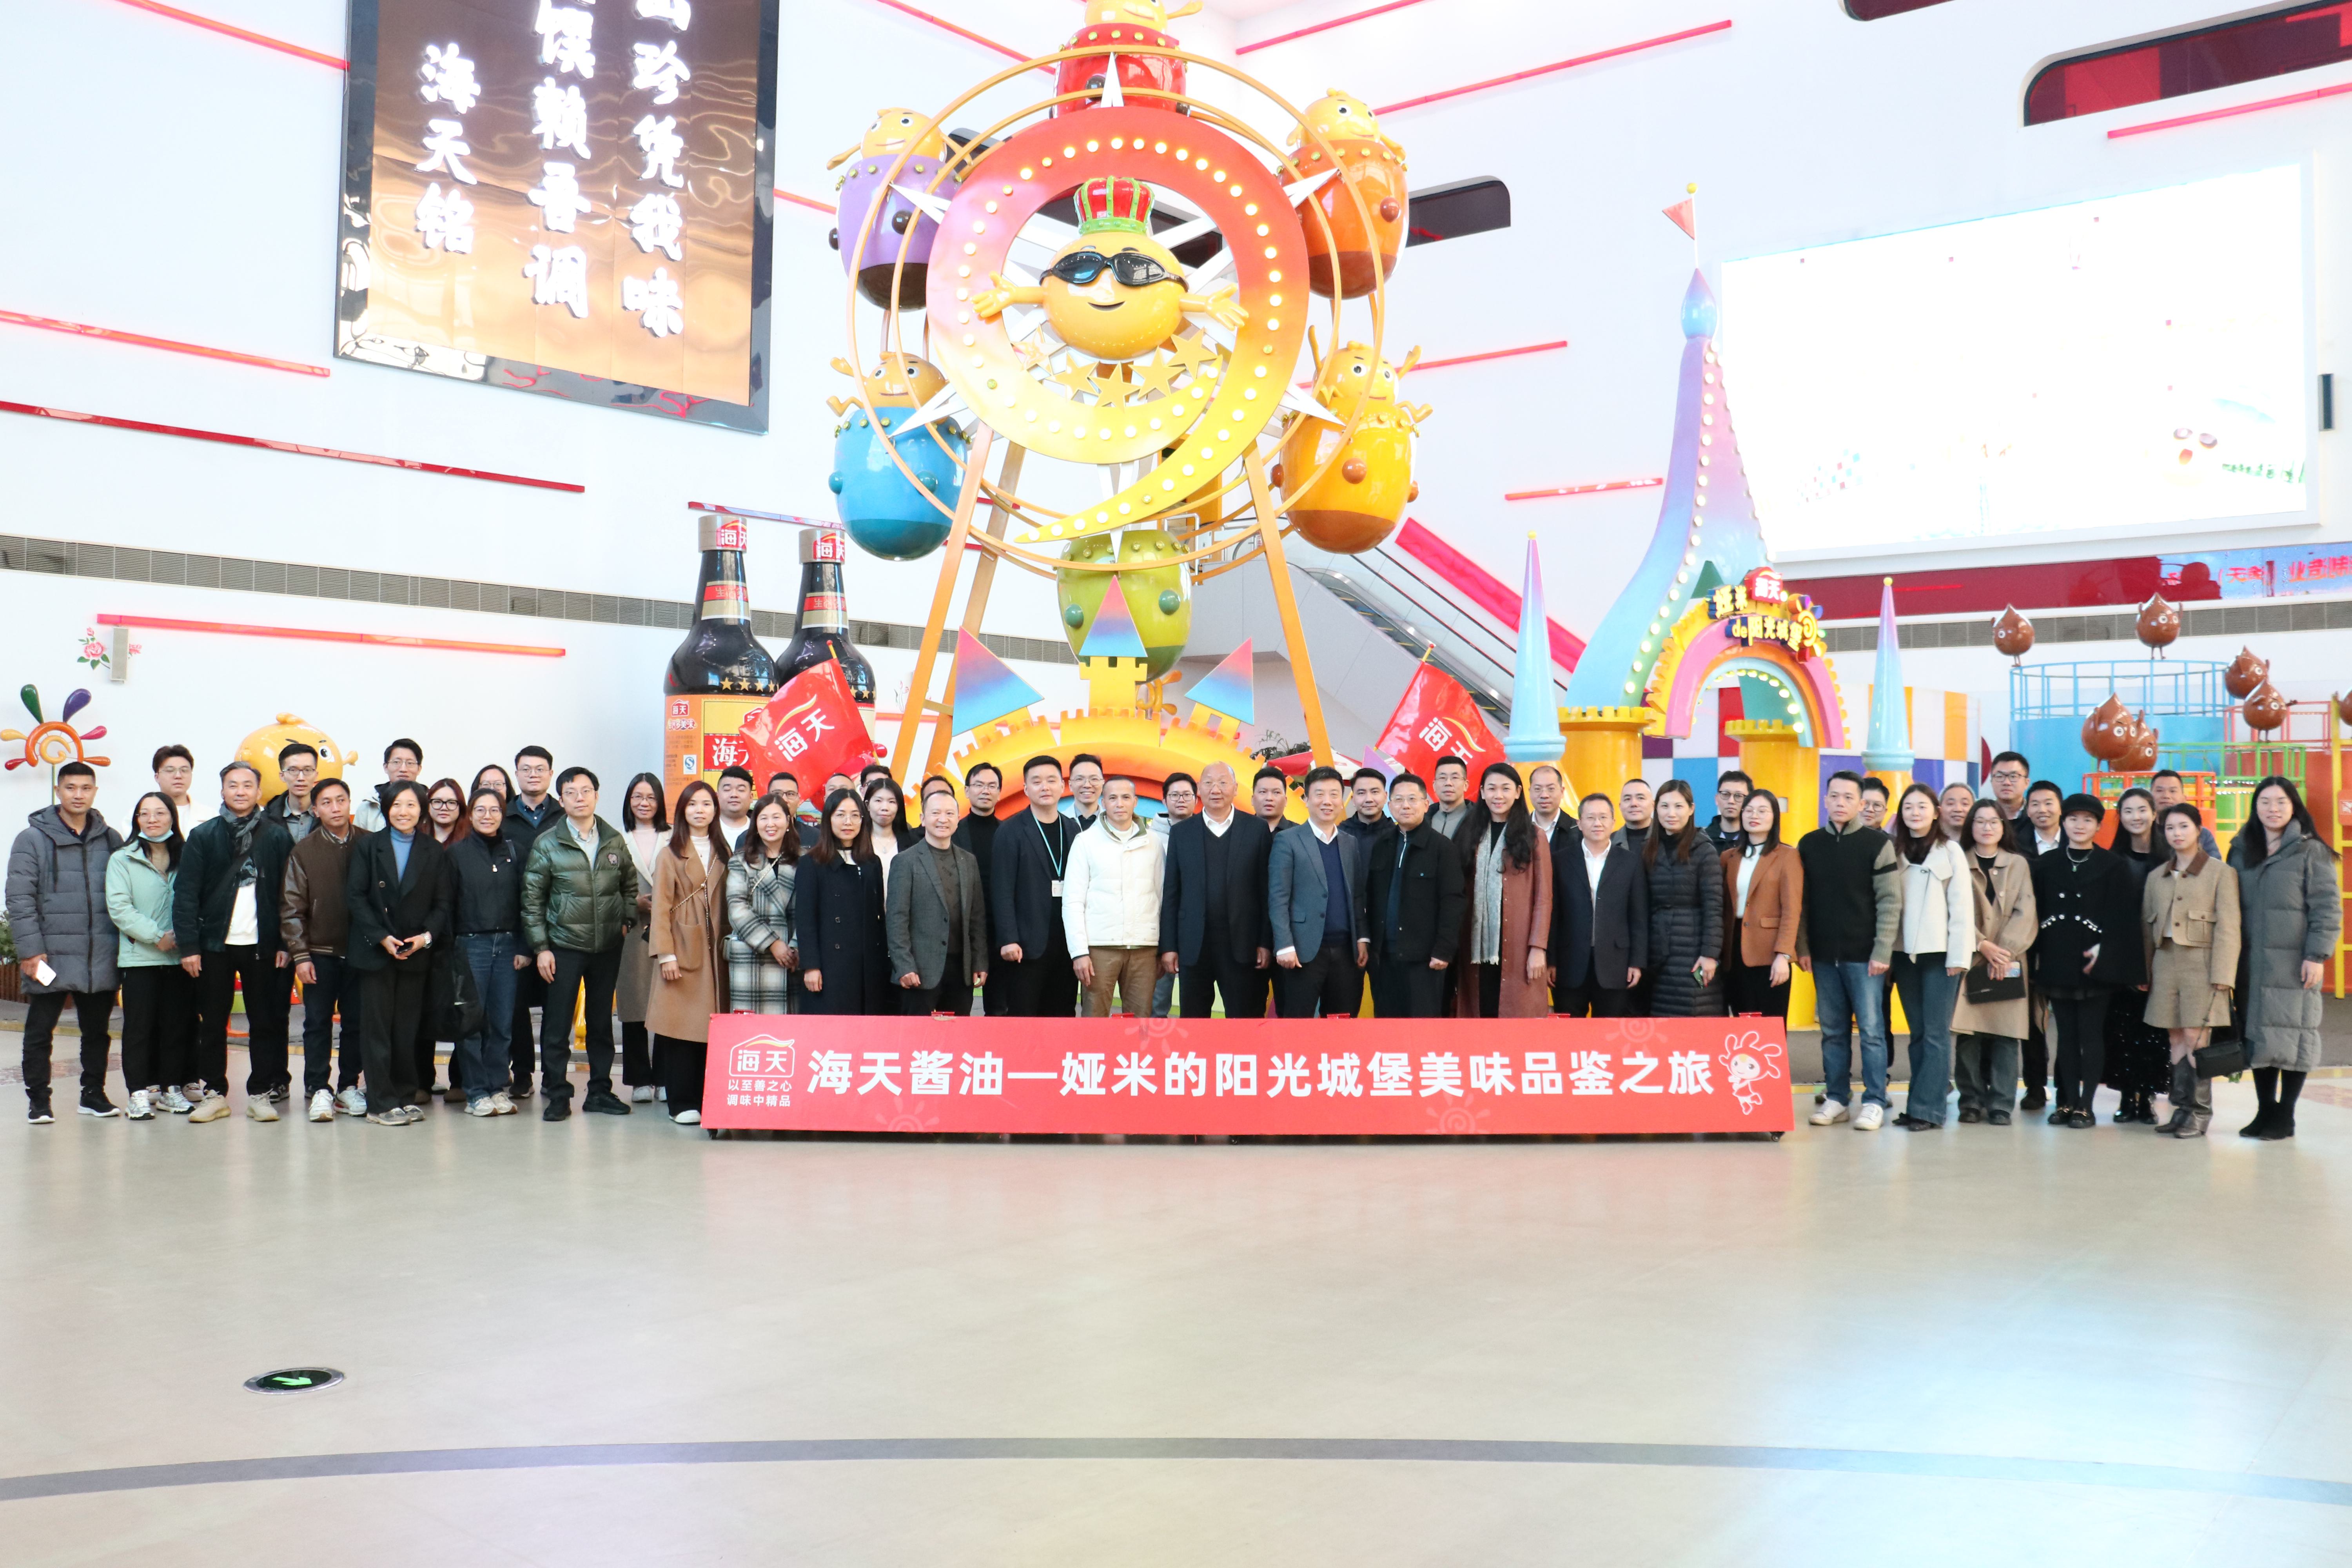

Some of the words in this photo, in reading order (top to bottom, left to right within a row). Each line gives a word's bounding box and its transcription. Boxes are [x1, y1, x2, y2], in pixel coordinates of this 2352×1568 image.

[416, 43, 481, 254] 海天铭
[524, 0, 596, 318] 馔赖吾调
[1755, 577, 1780, 600] 海天
[673, 706, 687, 715] 海天
[774, 708, 835, 762] 海天
[737, 1049, 787, 1073] 海天
[728, 1079, 792, 1092] 以至善之心
[807, 1050, 1714, 1098] 海天酱油—娅米的阳光城堡美味品鉴之旅
[727, 1094, 791, 1107] 调味中精品
